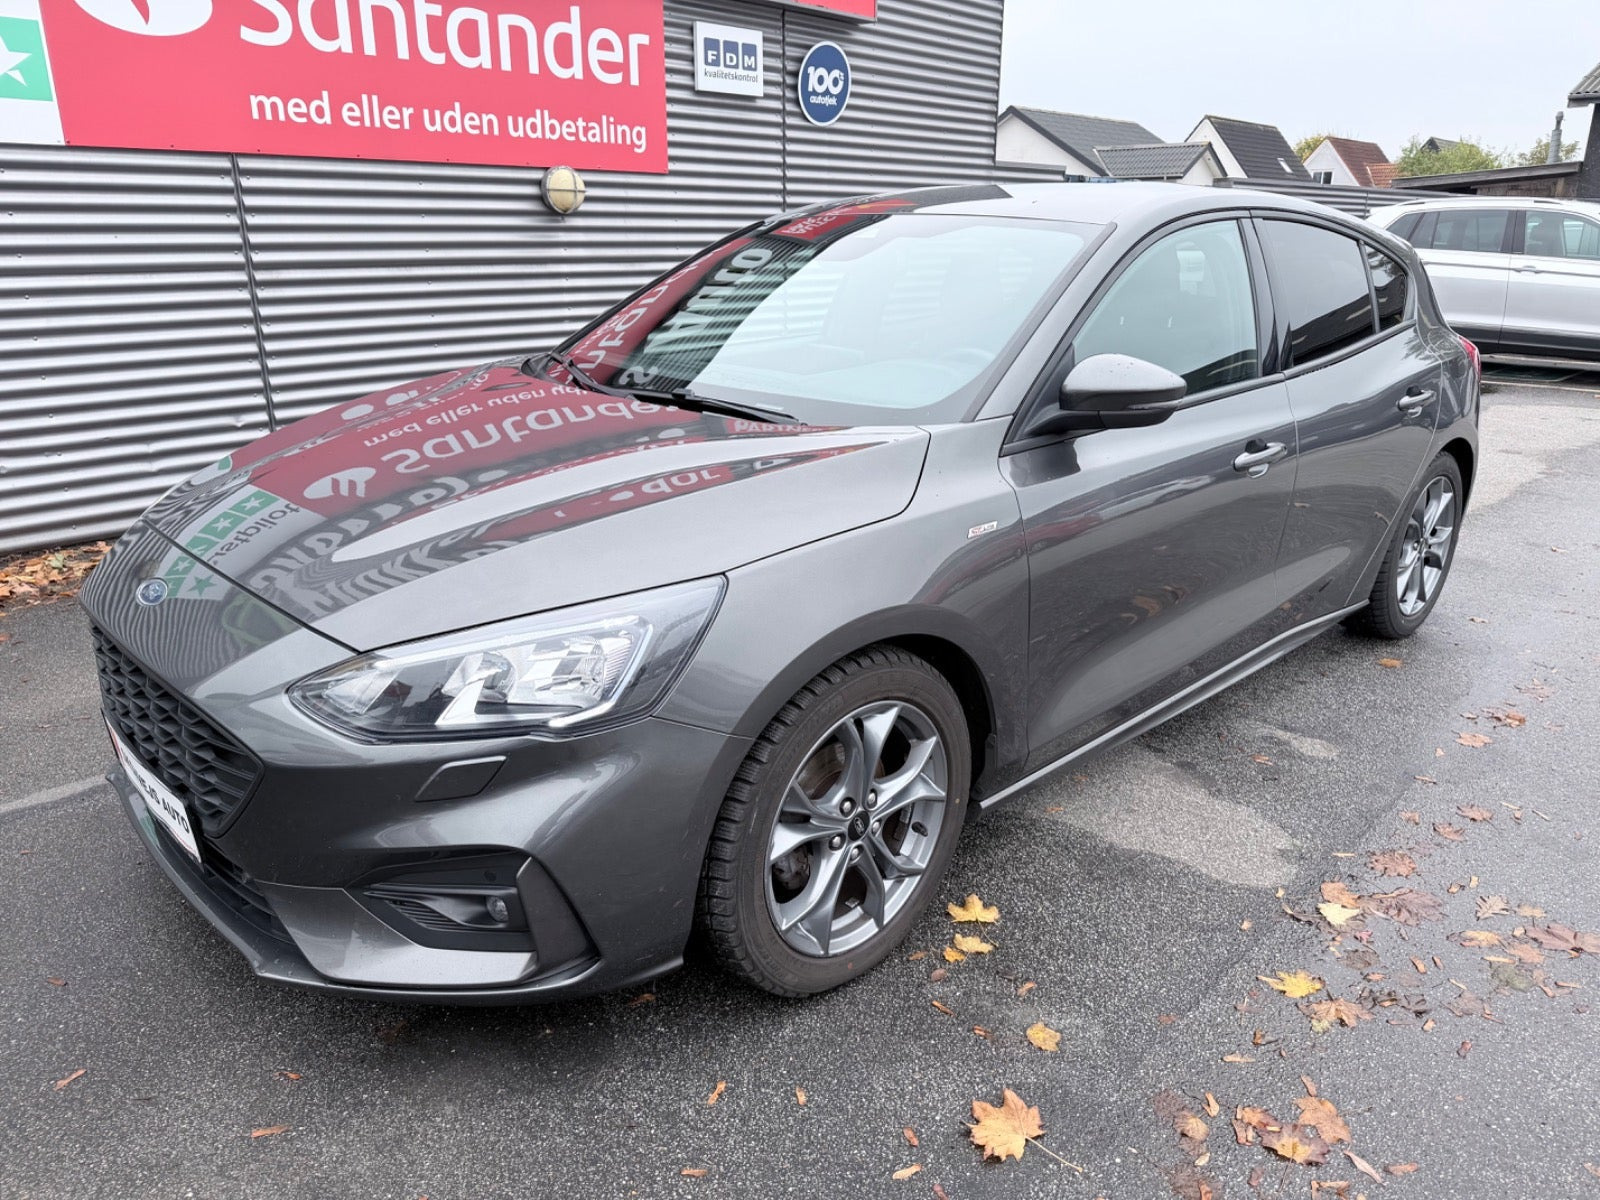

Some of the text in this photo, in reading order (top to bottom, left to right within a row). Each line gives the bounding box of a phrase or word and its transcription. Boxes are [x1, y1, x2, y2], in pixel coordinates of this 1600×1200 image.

[239, 0, 650, 87] Santander
[706, 49, 756, 69] FDM
[703, 67, 759, 83] kvalitetskontrol
[249, 90, 647, 154] med eller uden udbetaling
